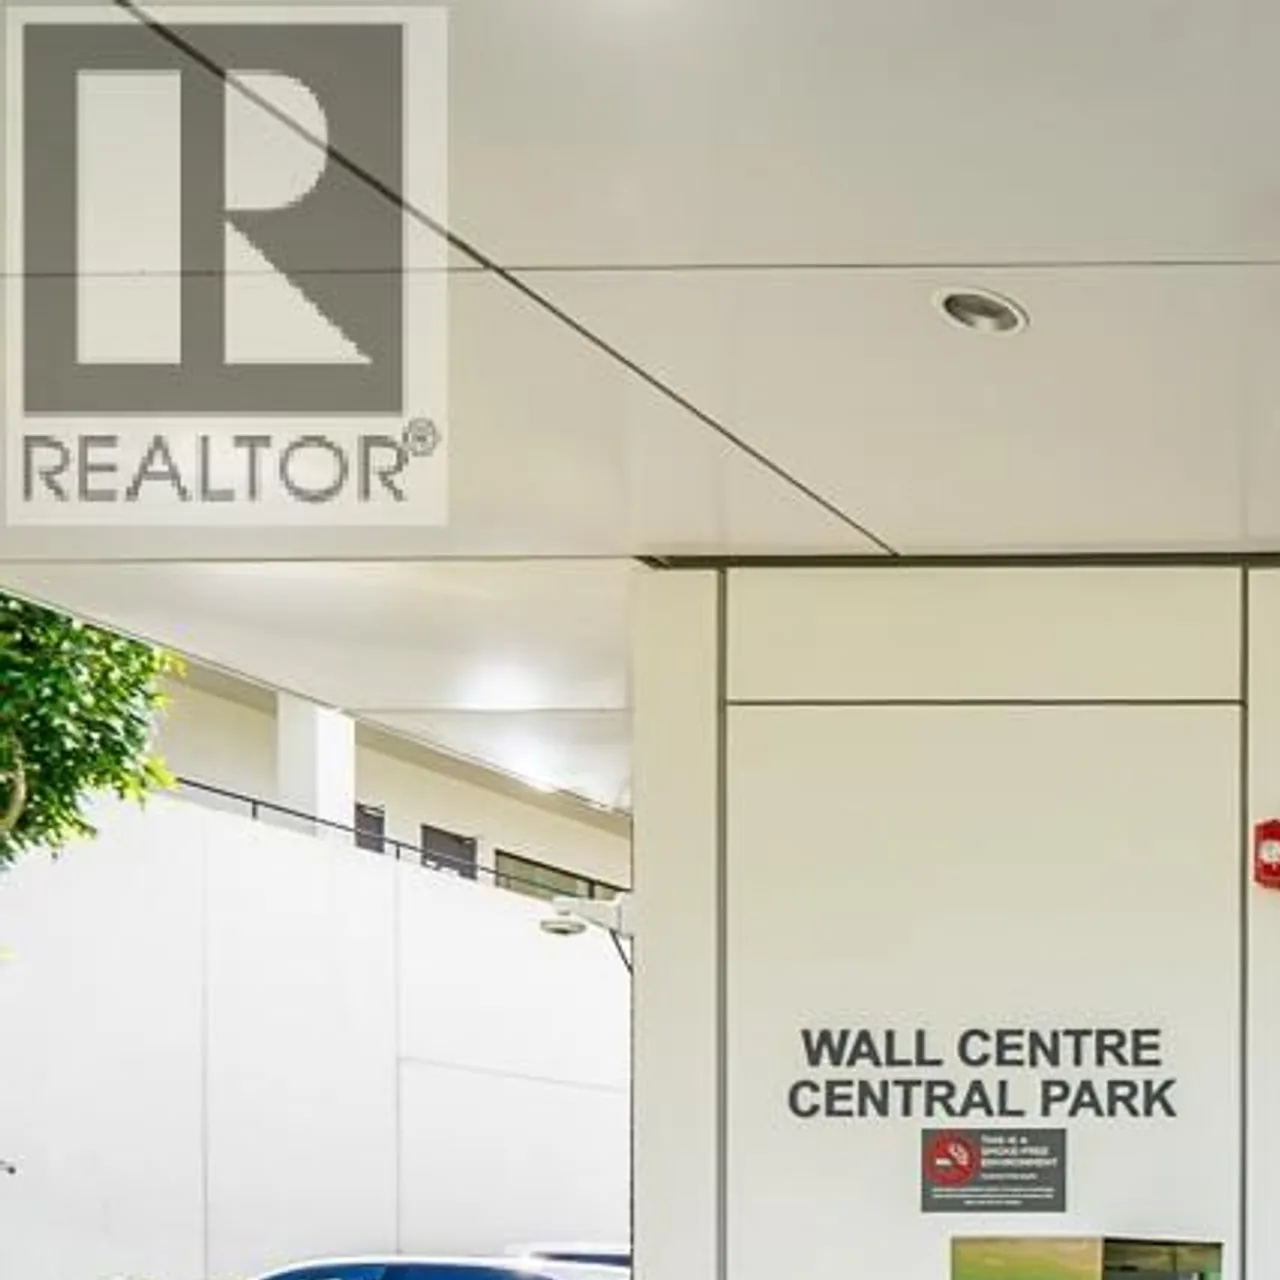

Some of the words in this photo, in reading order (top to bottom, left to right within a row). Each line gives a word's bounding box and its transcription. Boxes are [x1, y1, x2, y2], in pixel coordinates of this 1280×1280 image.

[800, 1028, 944, 1068] WALL
[957, 1028, 1162, 1068] CENTRE
[787, 1079, 1026, 1119] CENTRAL
[1040, 1079, 1178, 1119] PARK
